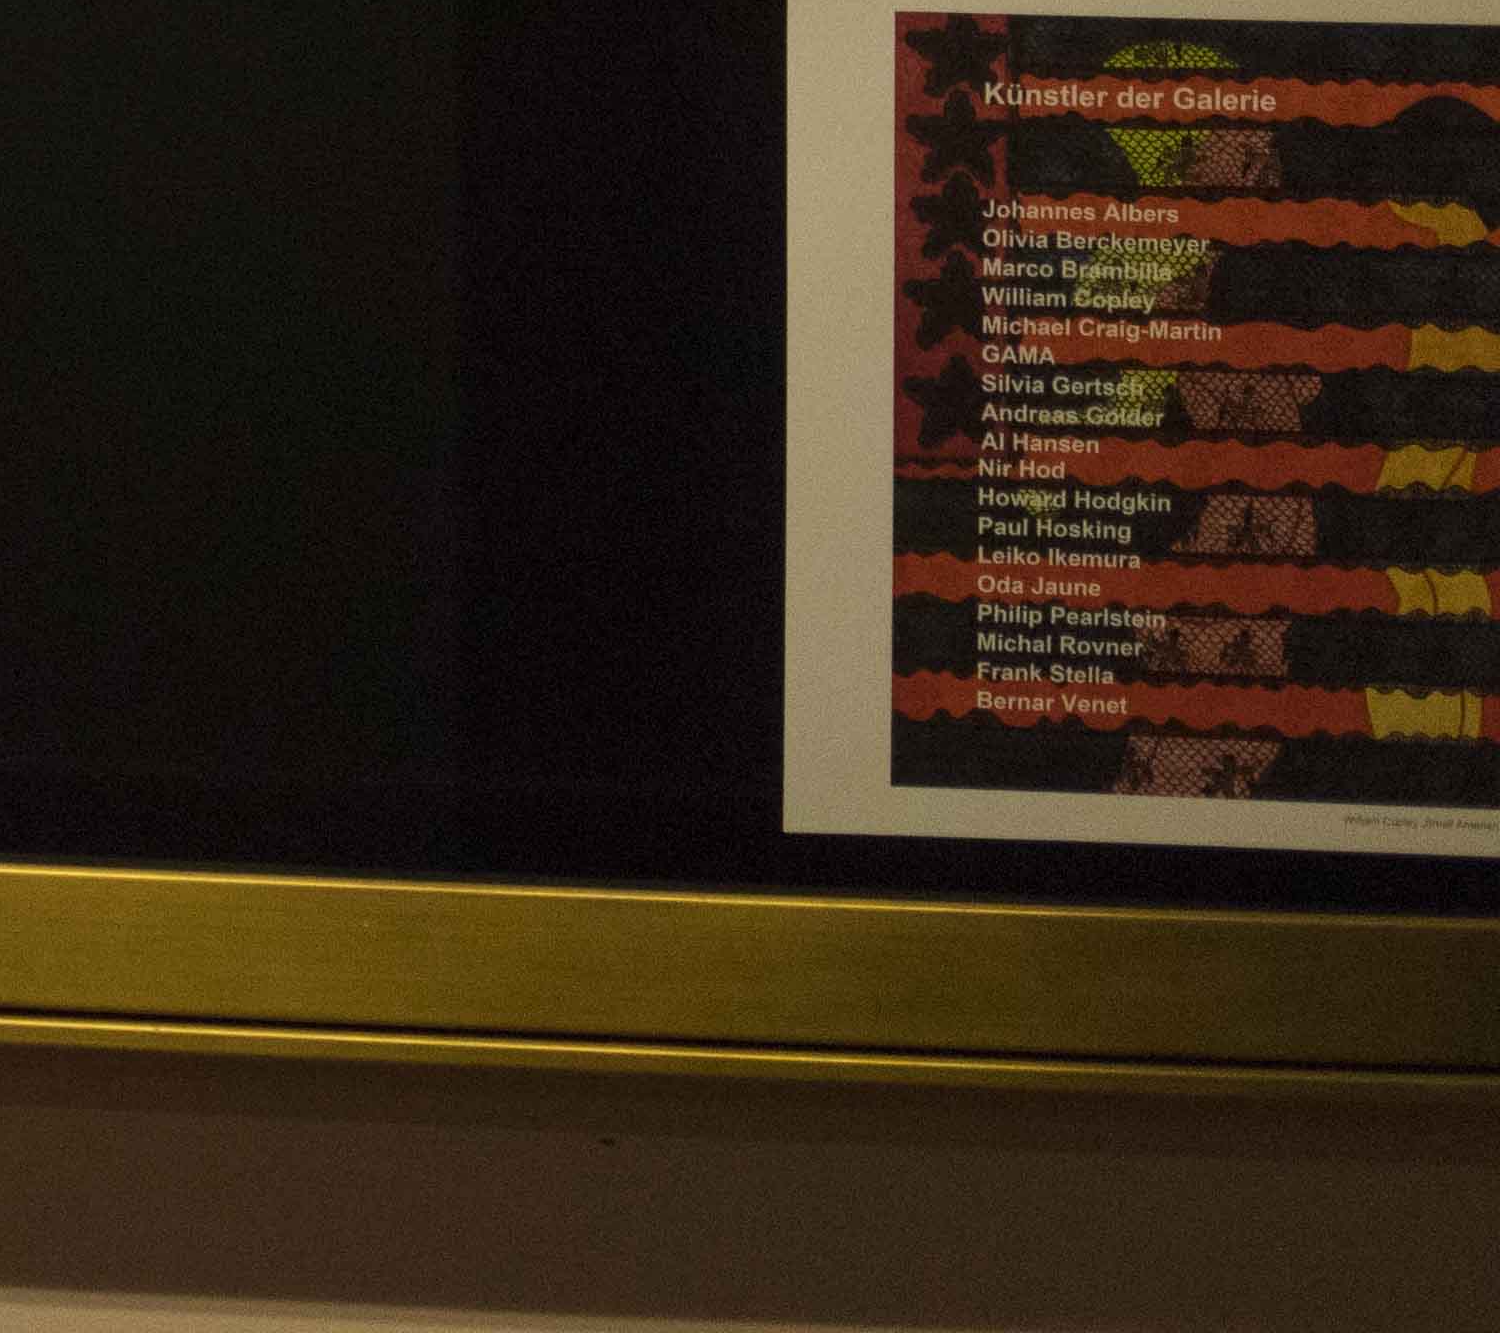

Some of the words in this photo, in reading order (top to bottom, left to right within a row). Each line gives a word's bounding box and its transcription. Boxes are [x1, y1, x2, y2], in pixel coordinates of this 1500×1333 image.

[985, 82, 1109, 108] Künstler
[1116, 85, 1165, 109] der
[1172, 86, 1277, 112] Galerie
[983, 199, 1096, 222] Johannes
[1103, 202, 1179, 224] Albers
[982, 227, 1048, 249] Olivia
[1056, 229, 1210, 255] Berckemeyer
[982, 256, 1054, 278] Marco
[1062, 256, 1174, 283] Brambilla
[981, 286, 1067, 307] William
[1073, 286, 1157, 314] Copley
[982, 315, 1071, 337] Michael
[1078, 317, 1222, 344] Craig-Martin
[981, 344, 1056, 364] GAMA
[981, 372, 1045, 394] Silvia
[1052, 372, 1145, 401] Gertsch
[981, 402, 1079, 425] Andreas
[1083, 402, 1164, 427] Golder
[981, 431, 1005, 451] Al
[1013, 433, 1100, 454] Hansen
[977, 458, 1012, 477] Nir
[1019, 459, 1066, 479] Hod
[978, 487, 1067, 513] Howard
[1074, 490, 1172, 516] Hodgkin
[977, 515, 1029, 536] Paul
[1035, 517, 1132, 545] Hosking
[977, 545, 1042, 567] Leiko
[1047, 548, 1142, 570] Ikemura
[977, 574, 1024, 595] Oda
[1030, 576, 1102, 597] Jaune
[977, 602, 1043, 629] Philip
[1050, 605, 1168, 634] Pearlstein
[977, 631, 1052, 653] Michal
[1059, 634, 1145, 657] Rovner
[976, 661, 1043, 683] Frank
[1049, 663, 1115, 686] Stella
[976, 689, 1055, 712] Bernar
[1060, 693, 1128, 715] Venet
